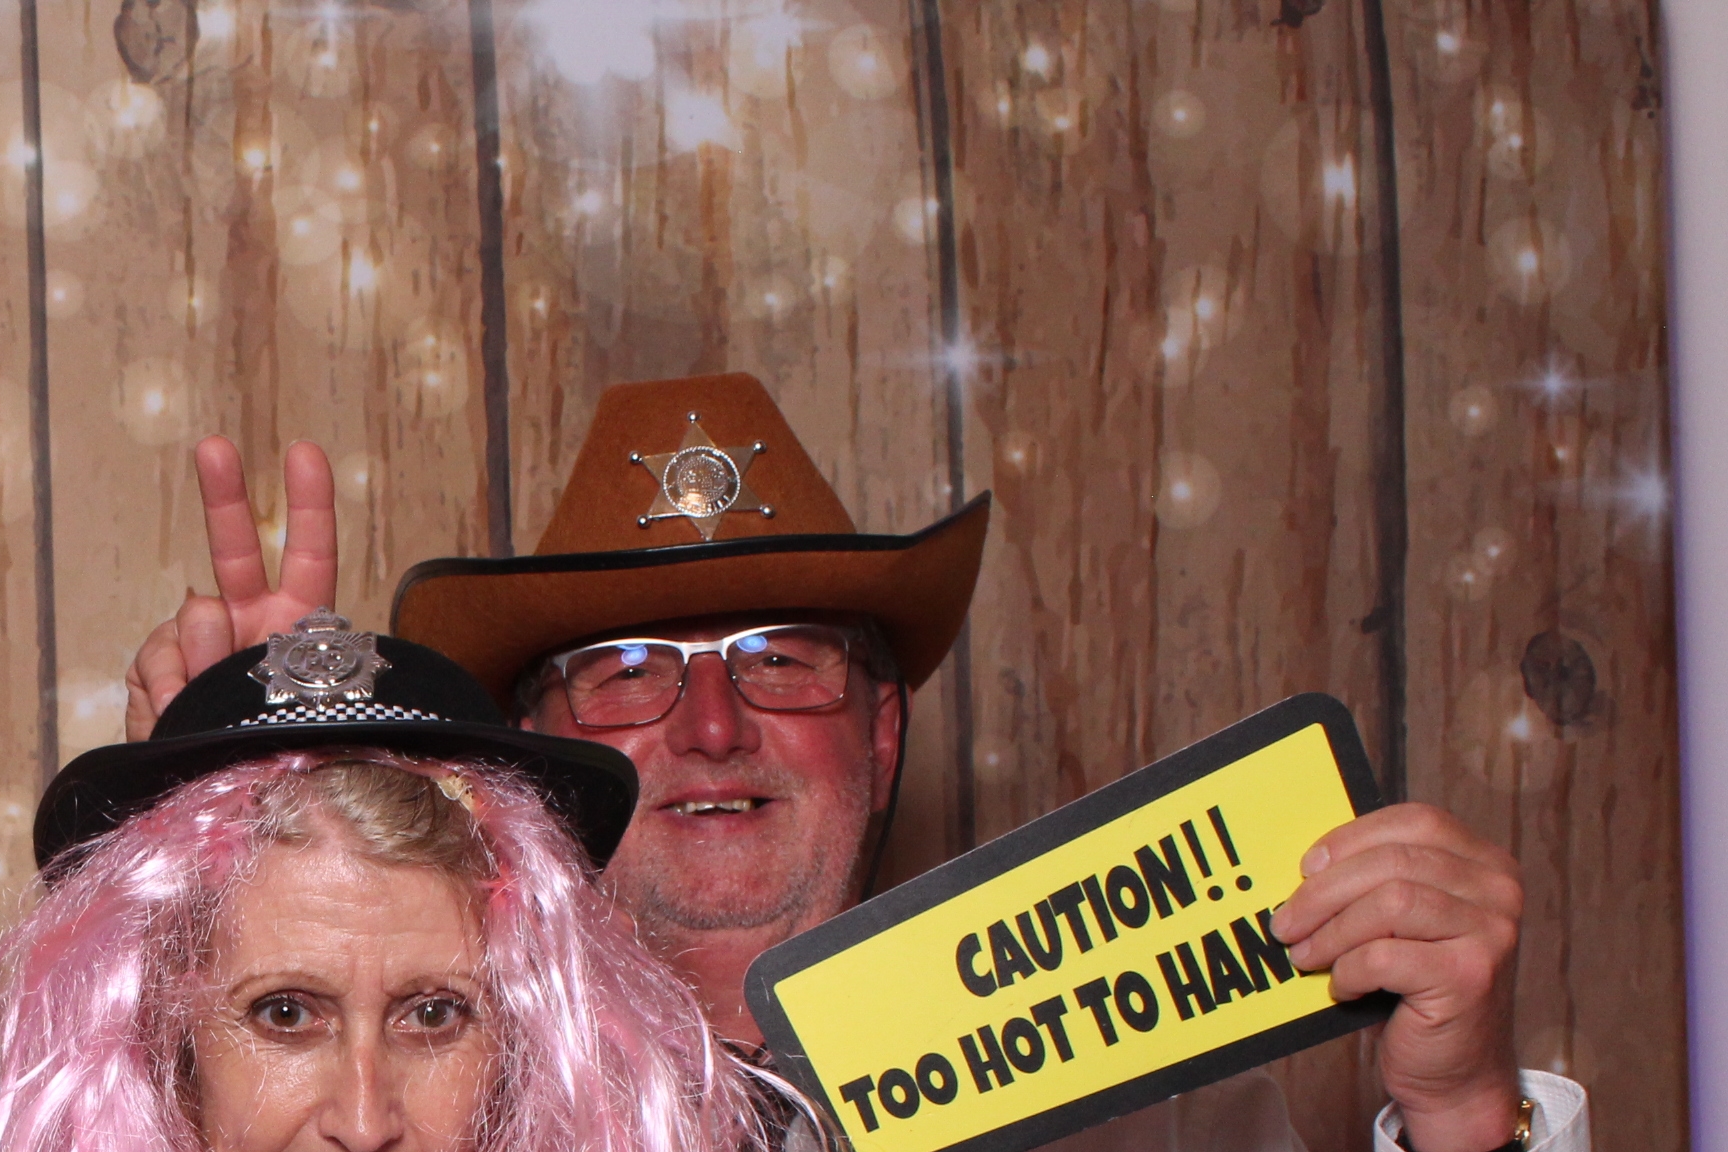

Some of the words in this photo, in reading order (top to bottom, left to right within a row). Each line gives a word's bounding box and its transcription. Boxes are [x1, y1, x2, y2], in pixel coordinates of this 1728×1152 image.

[956, 805, 1252, 997] CAUTION!!
[840, 1053, 959, 1133] TOO
[958, 995, 1075, 1094] HOT
[1074, 971, 1160, 1047] TO
[1156, 900, 1312, 1021] HAN
